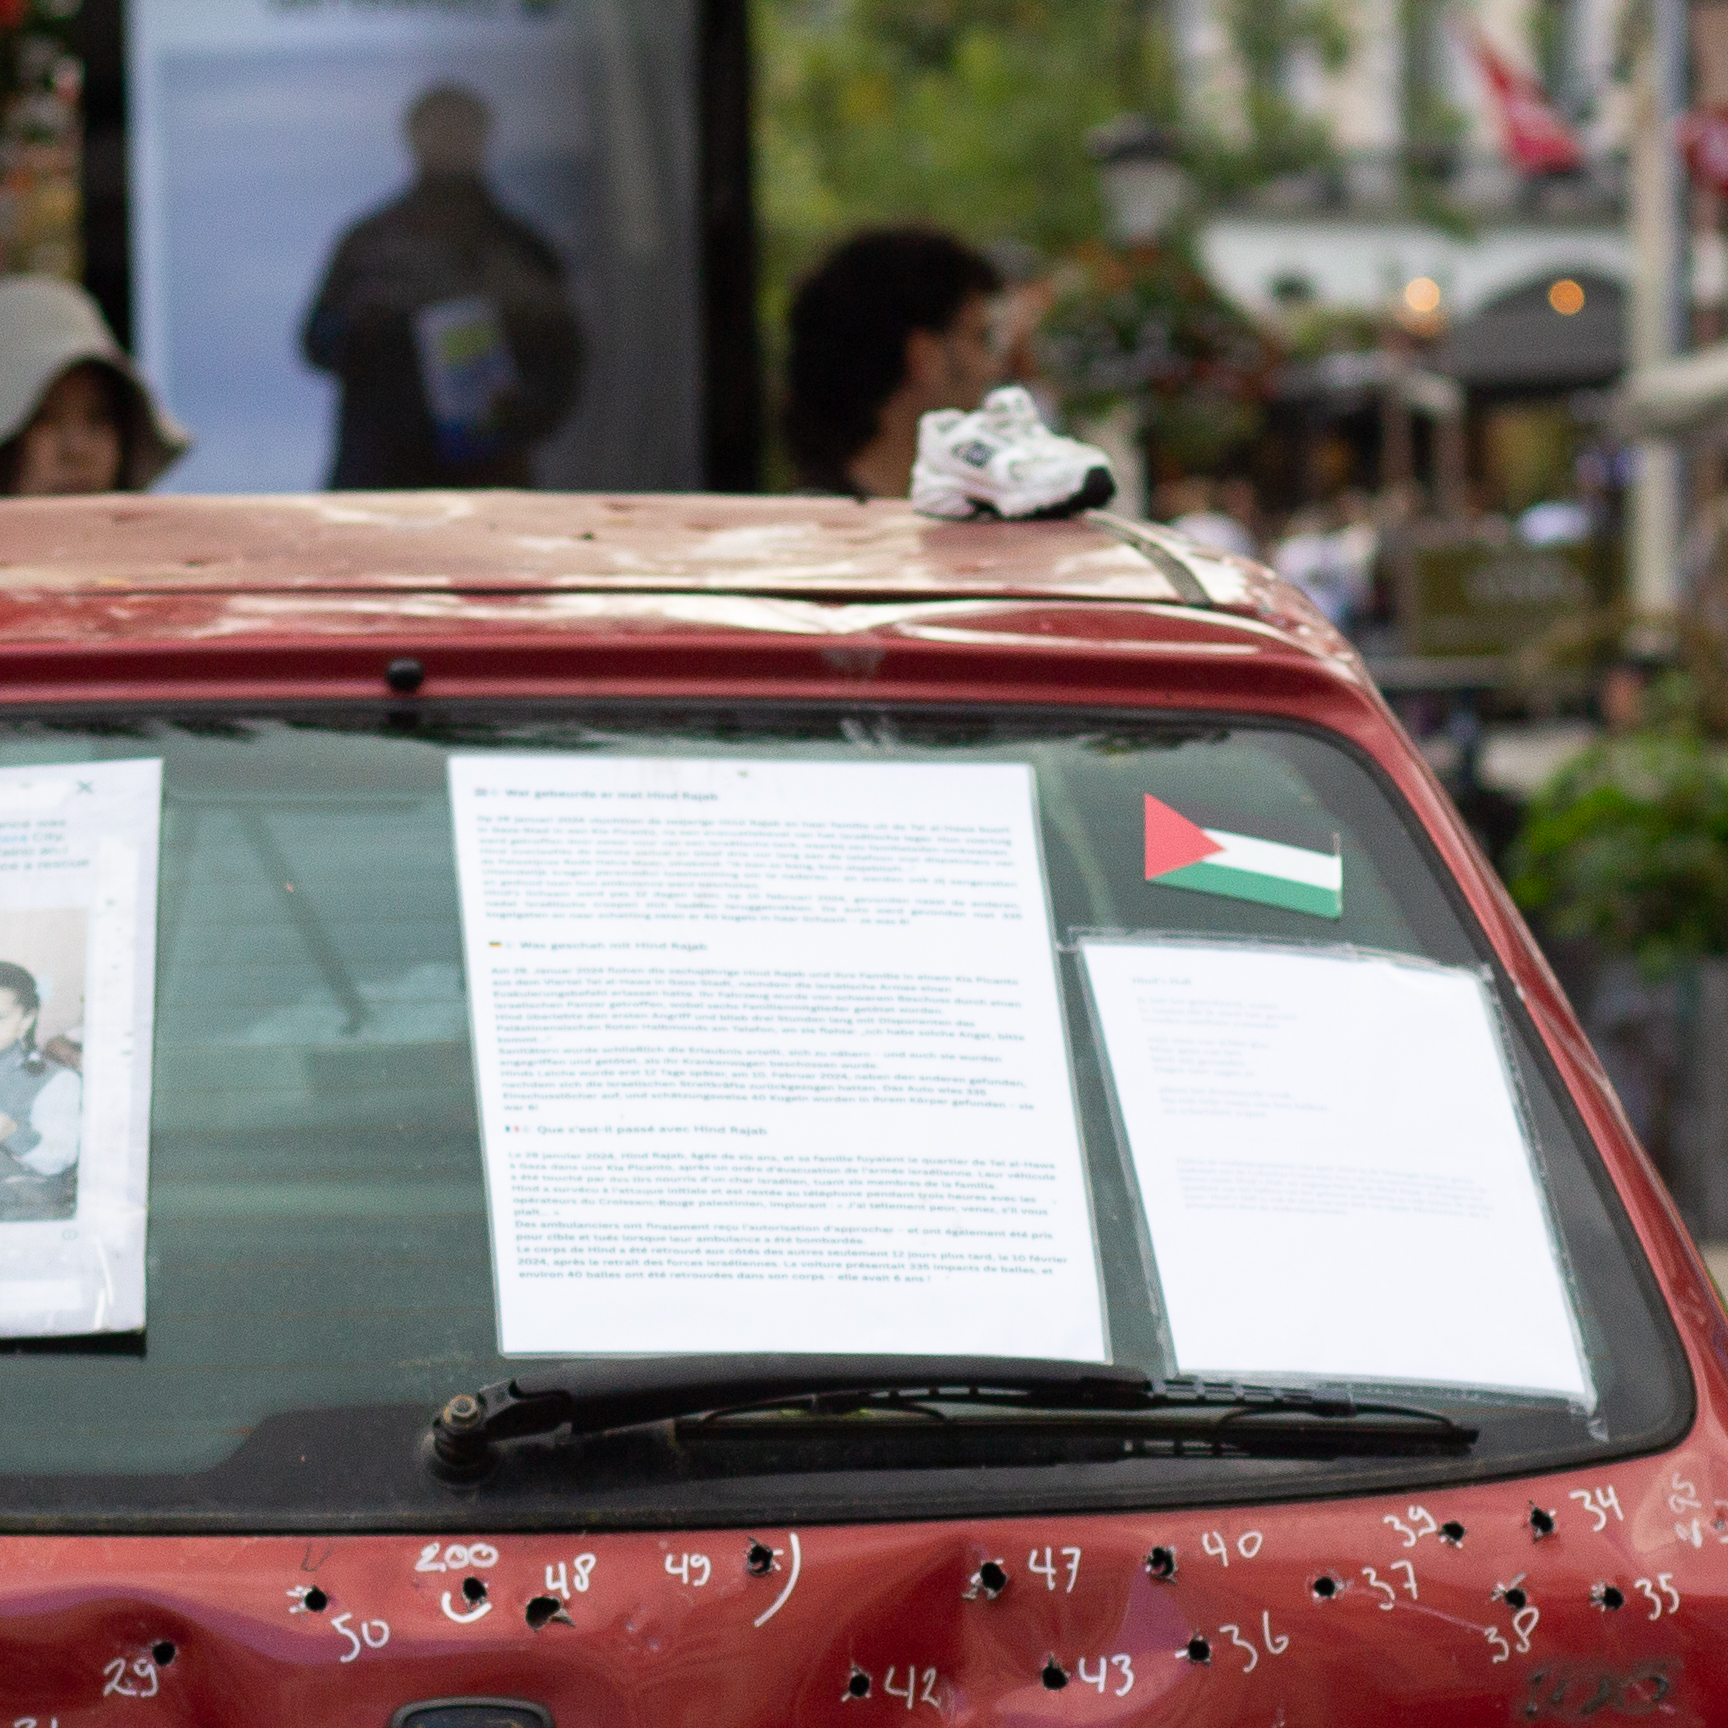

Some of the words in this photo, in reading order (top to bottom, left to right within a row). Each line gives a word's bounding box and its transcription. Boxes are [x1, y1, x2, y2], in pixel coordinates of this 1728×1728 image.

[505, 789, 530, 797] Wat
[534, 790, 597, 800] gebeurde
[601, 791, 612, 799] er
[617, 791, 642, 799] met
[647, 790, 678, 800] Hind
[682, 791, 719, 802] Rajab
[519, 942, 546, 950] Was
[551, 942, 605, 952] geschah
[610, 942, 630, 950] mit
[635, 942, 667, 950] Hind
[671, 942, 708, 952] Rajab
[537, 1125, 564, 1134] Que
[568, 1125, 612, 1133] s'est-il
[617, 1125, 655, 1135] passé
[694, 1125, 726, 1134] Hind
[731, 1126, 767, 1137] Rajab
[519, 1271, 564, 1279] environ
[586, 1270, 621, 1279] balles
[625, 1271, 644, 1279] ont
[648, 1271, 666, 1279] été
[669, 1271, 733, 1280] retrouvées
[737, 1272, 764, 1280] dans
[792, 1273, 824, 1281] corps
[838, 1273, 858, 1281] elle
[553, 1258, 585, 1267] après
[603, 1259, 640, 1267] retrait
[643, 1259, 664, 1267] des
[667, 1259, 703, 1267] forces
[845, 1261, 905, 1271] présentait
[933, 1263, 980, 1272] impacts
[1383, 1506, 1438, 1547] 39
[1571, 1485, 1623, 1533] 34
[415, 1542, 500, 1573] 200
[1028, 1546, 1081, 1593] 47
[1202, 1530, 1263, 1567] 40
[545, 1553, 597, 1599] 48
[664, 1553, 712, 1587] 49
[1362, 1560, 1418, 1611] 37
[1634, 1572, 1682, 1621] 35
[332, 1613, 390, 1662] 50
[1219, 1611, 1290, 1673] 36
[1483, 1606, 1542, 1664] 38
[103, 1658, 159, 1698] 29
[883, 1665, 940, 1709] 42
[1078, 1654, 1135, 1697] 43
